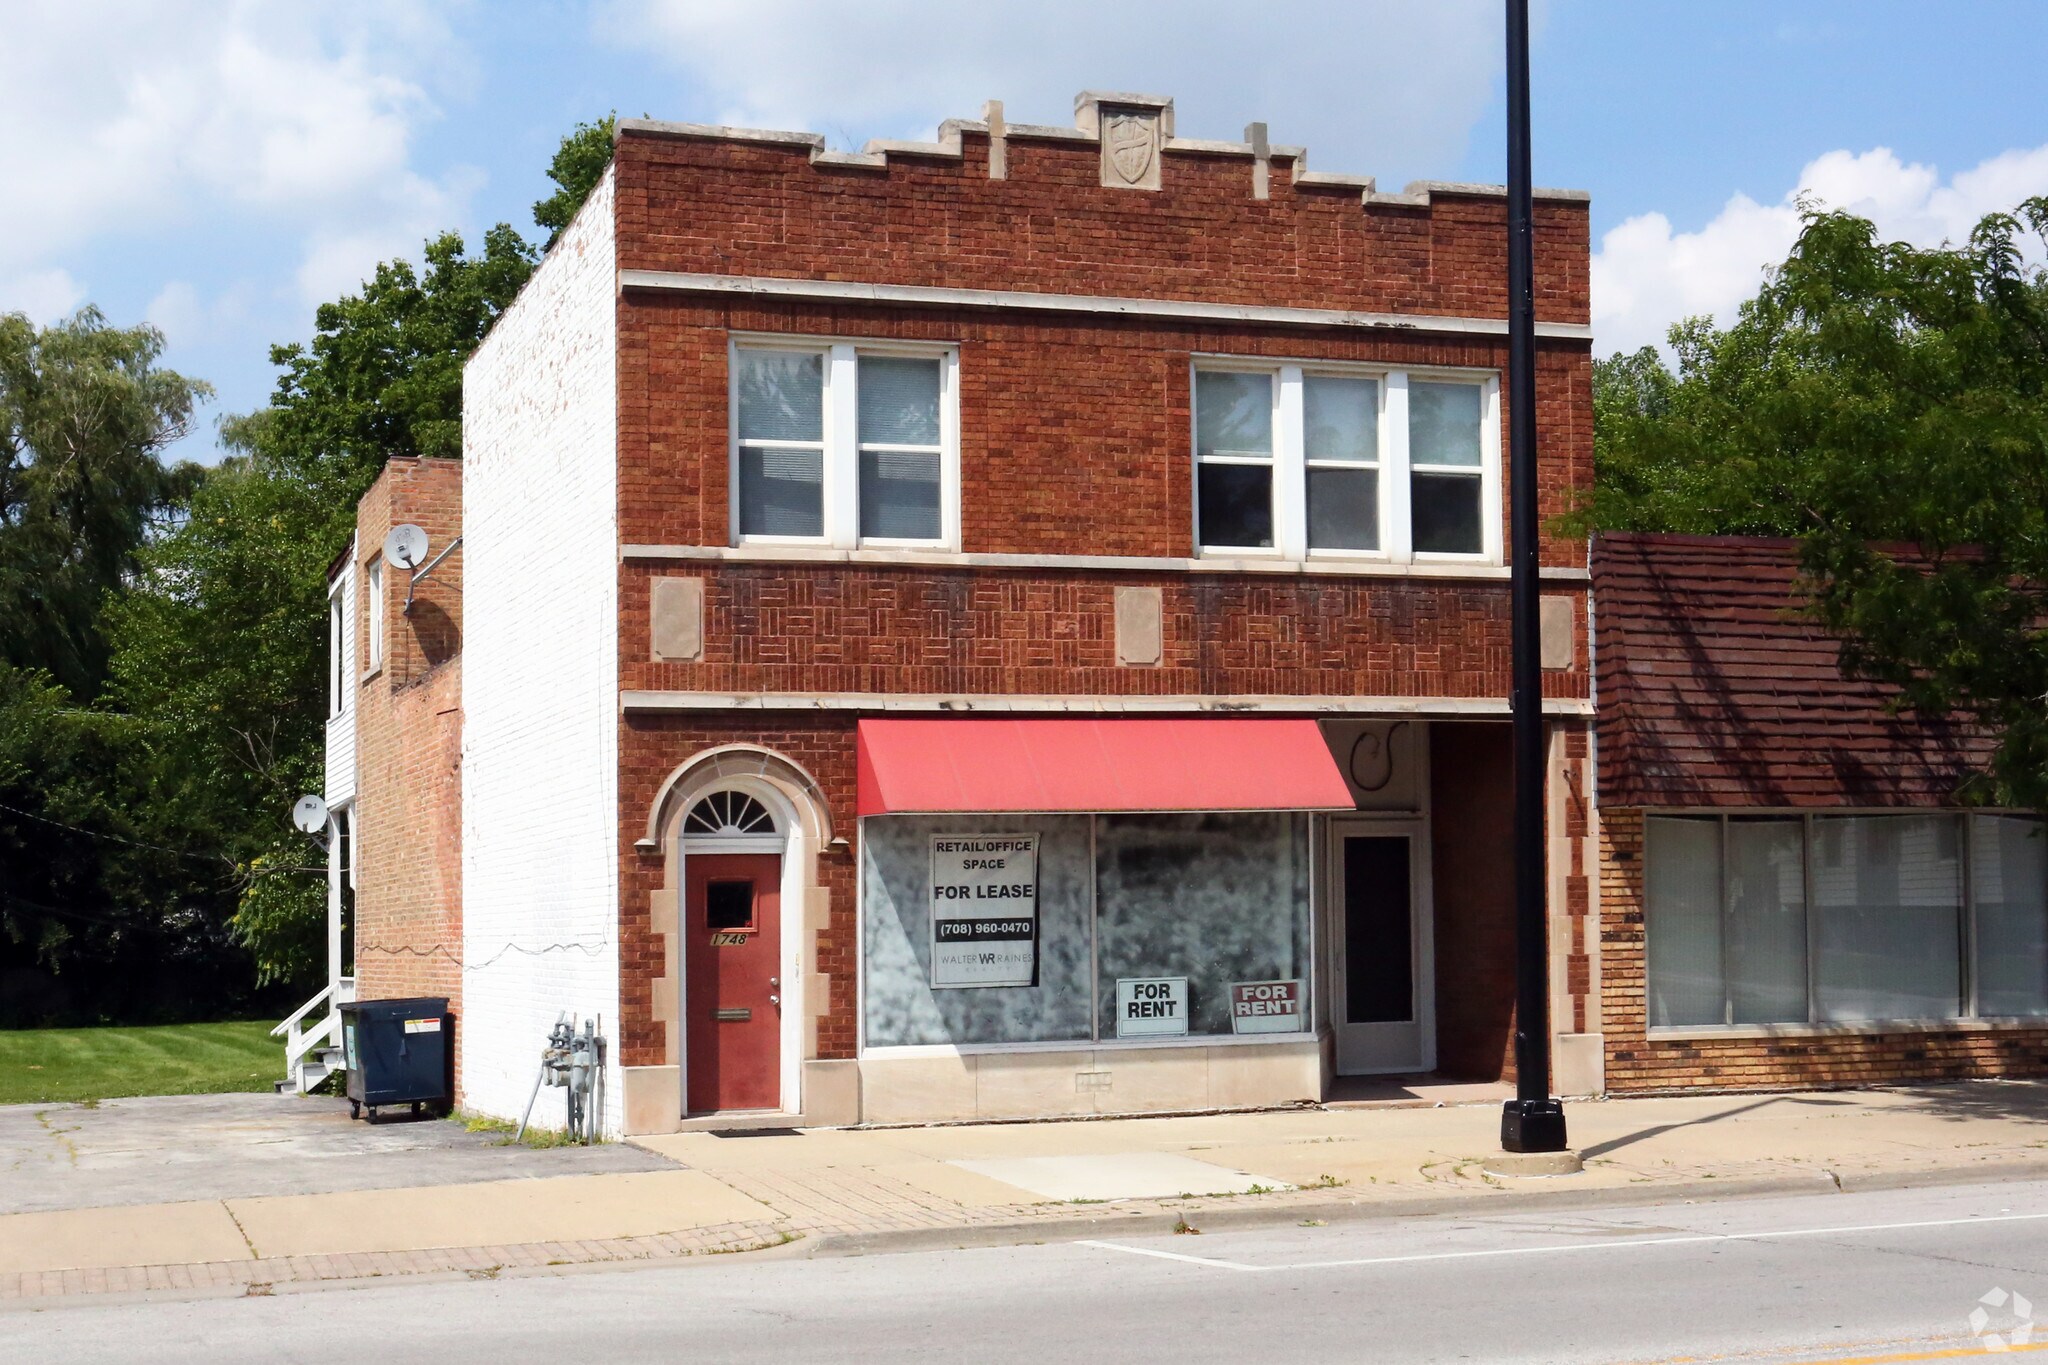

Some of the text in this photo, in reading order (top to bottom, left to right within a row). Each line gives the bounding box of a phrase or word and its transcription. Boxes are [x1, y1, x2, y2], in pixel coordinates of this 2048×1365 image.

[936, 841, 1032, 852] RETAIL/OFFICE
[963, 859, 1005, 870] SPACE
[934, 884, 1033, 900] FOR LEASE
[940, 922, 1030, 936] (708) 960-0470
[713, 934, 747, 945] 1748
[942, 954, 977, 964] WALTER
[997, 953, 1032, 963] RAINES
[1134, 983, 1171, 999] FOR
[1242, 985, 1288, 1000] FOR
[1128, 1001, 1177, 1018] RENT
[1235, 1000, 1296, 1016] RENT
